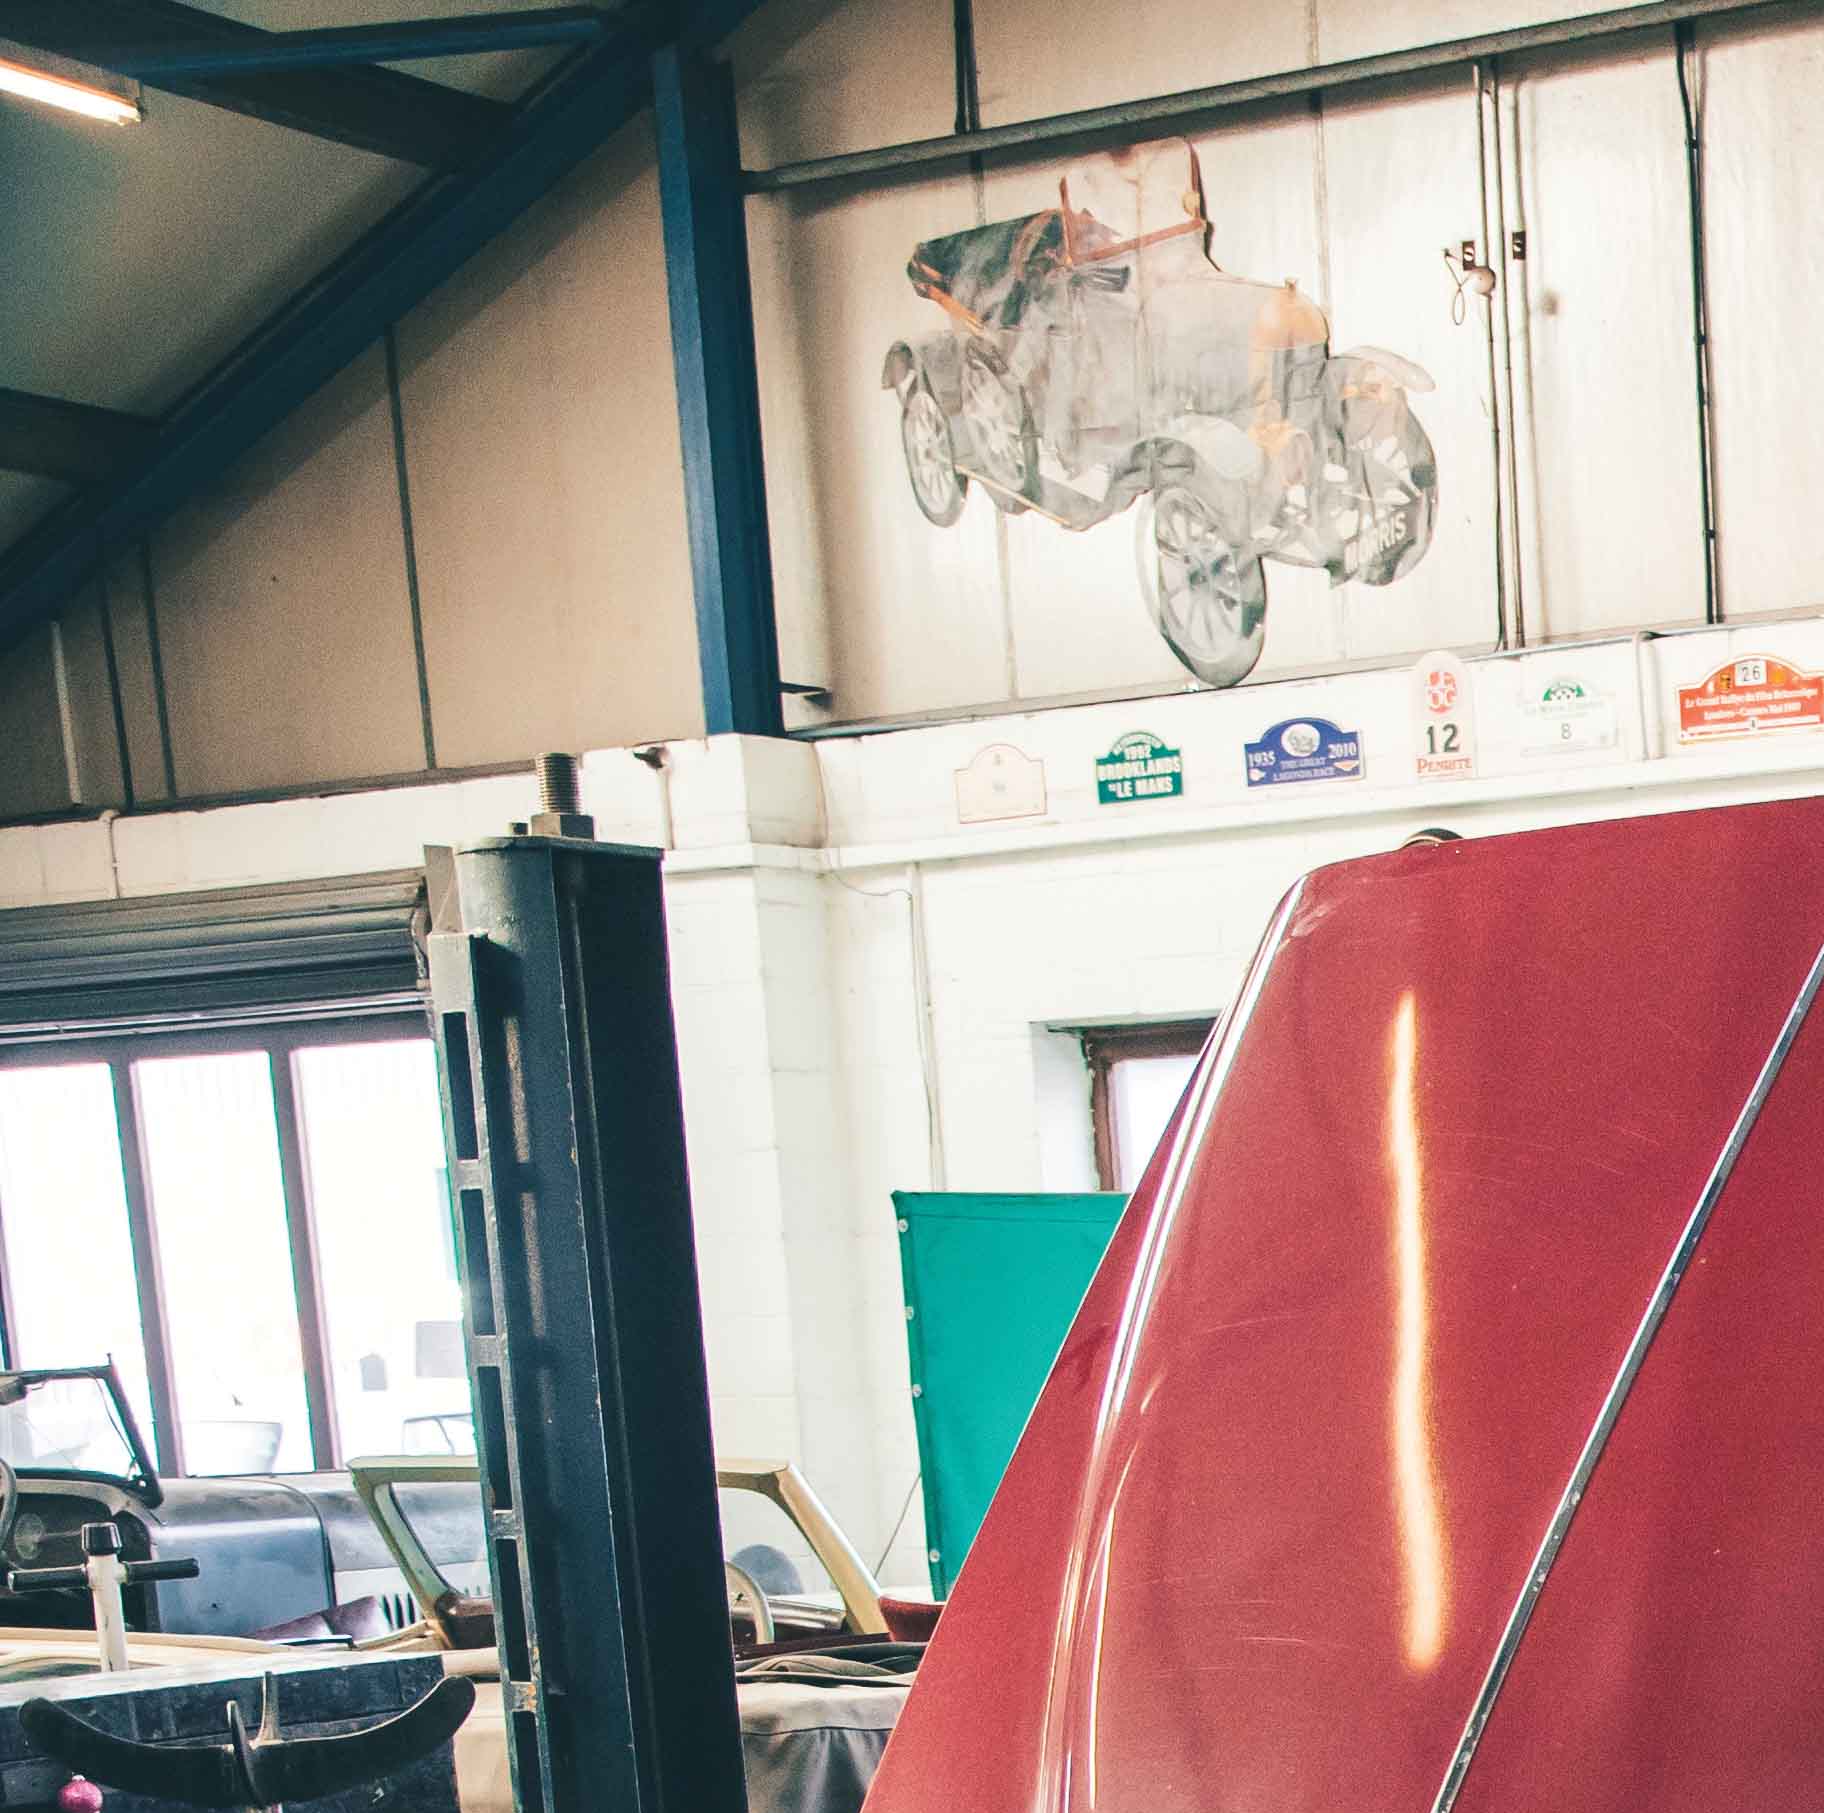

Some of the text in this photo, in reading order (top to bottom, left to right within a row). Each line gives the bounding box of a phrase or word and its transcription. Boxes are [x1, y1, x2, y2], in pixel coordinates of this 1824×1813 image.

[1741, 665, 1761, 682] 26
[1426, 723, 1460, 754] 12
[1248, 750, 1277, 768] 1935
[1328, 742, 1358, 759] 2010
